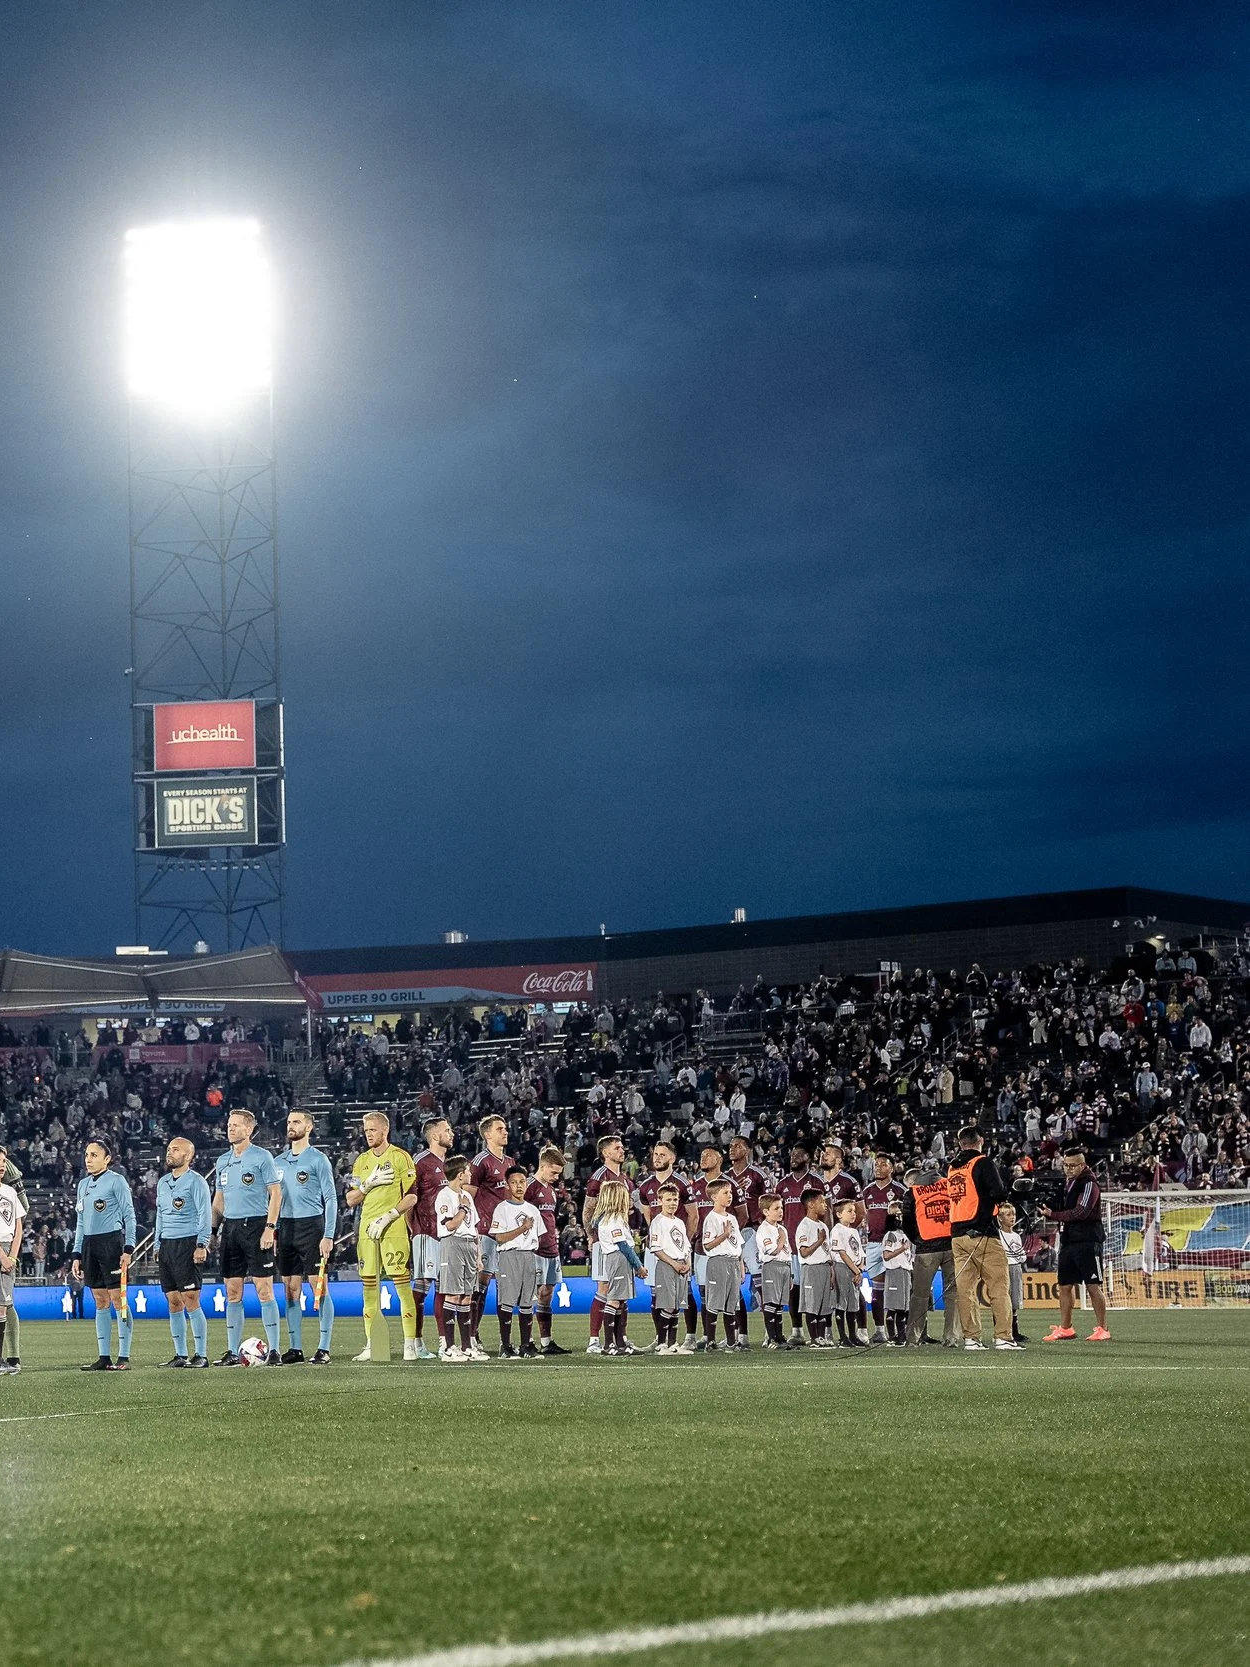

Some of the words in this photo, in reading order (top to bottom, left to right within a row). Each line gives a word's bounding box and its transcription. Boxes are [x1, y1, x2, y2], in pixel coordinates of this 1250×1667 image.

[171, 723, 238, 742] uchealth
[163, 788, 185, 797] EVERY
[185, 787, 213, 796] SEASON
[213, 787, 238, 796] STARTS
[168, 796, 244, 826] DICK'S
[169, 824, 212, 833] SPORTING
[213, 822, 244, 831] GOODS
[327, 993, 369, 1005] UPPER
[371, 993, 387, 1003] 90
[390, 991, 426, 1002] GRILL
[386, 1251, 407, 1267] 22
[1140, 1279, 1199, 1299] TIRE
[1213, 1284, 1250, 1294] BODYAR
